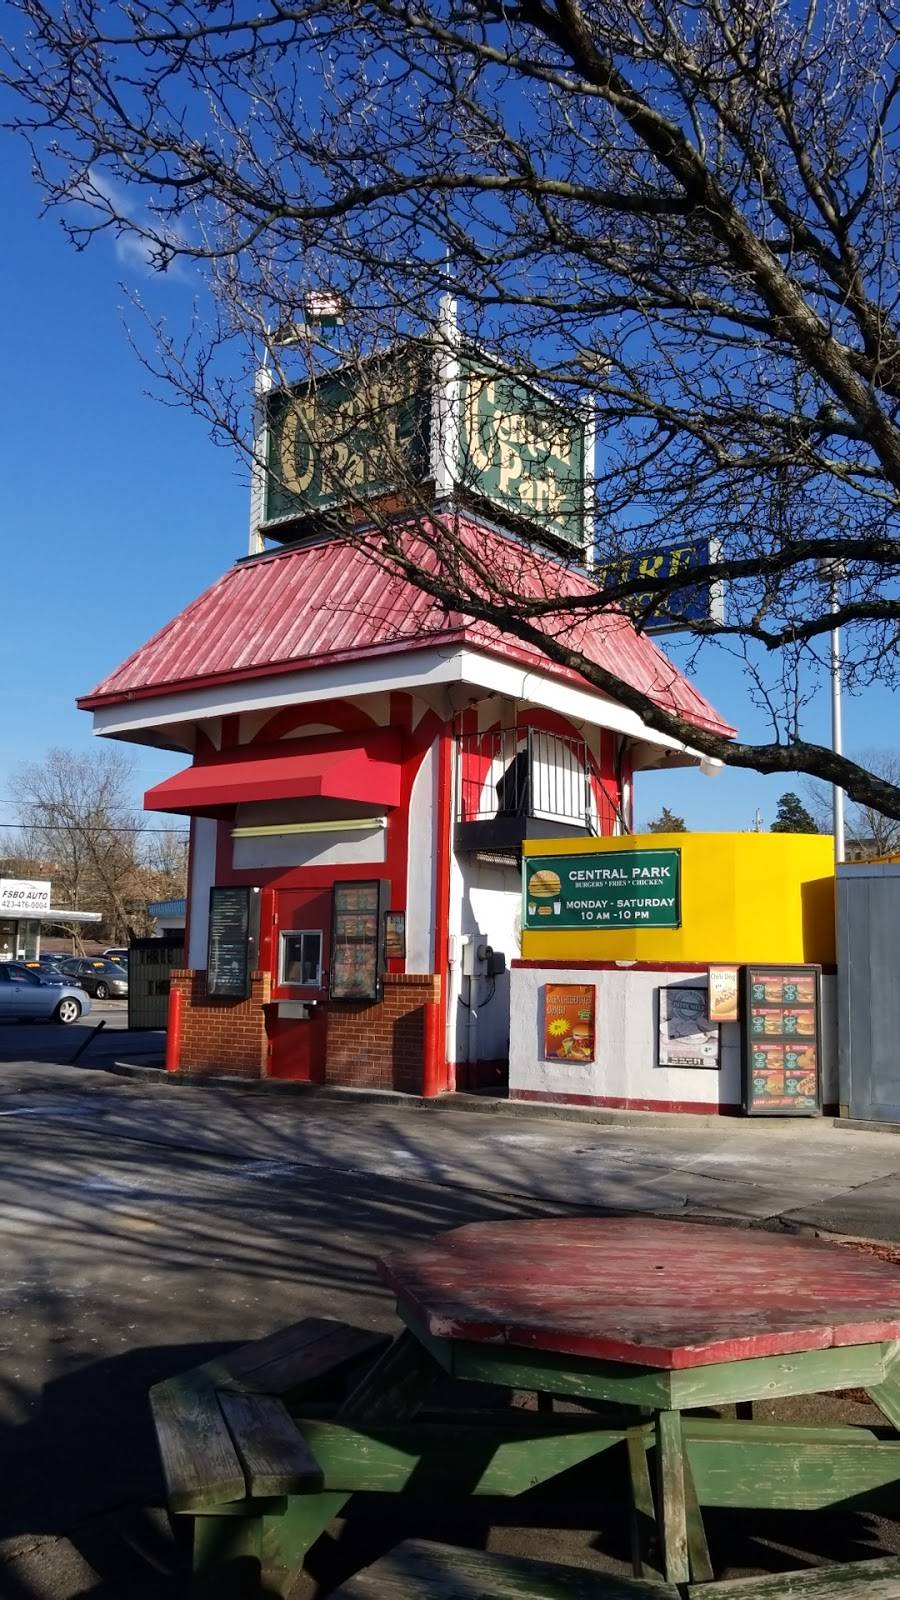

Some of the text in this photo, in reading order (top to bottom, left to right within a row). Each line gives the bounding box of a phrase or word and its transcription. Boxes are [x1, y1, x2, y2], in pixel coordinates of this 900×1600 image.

[499, 440, 567, 526] Park
[568, 867, 671, 881] CENTRAL PARK
[2, 890, 48, 900] FSBO AUTO
[566, 900, 608, 909] MONDAY
[617, 898, 675, 908] SATURDAY
[581, 912, 593, 920] 10
[634, 911, 649, 919] PM
